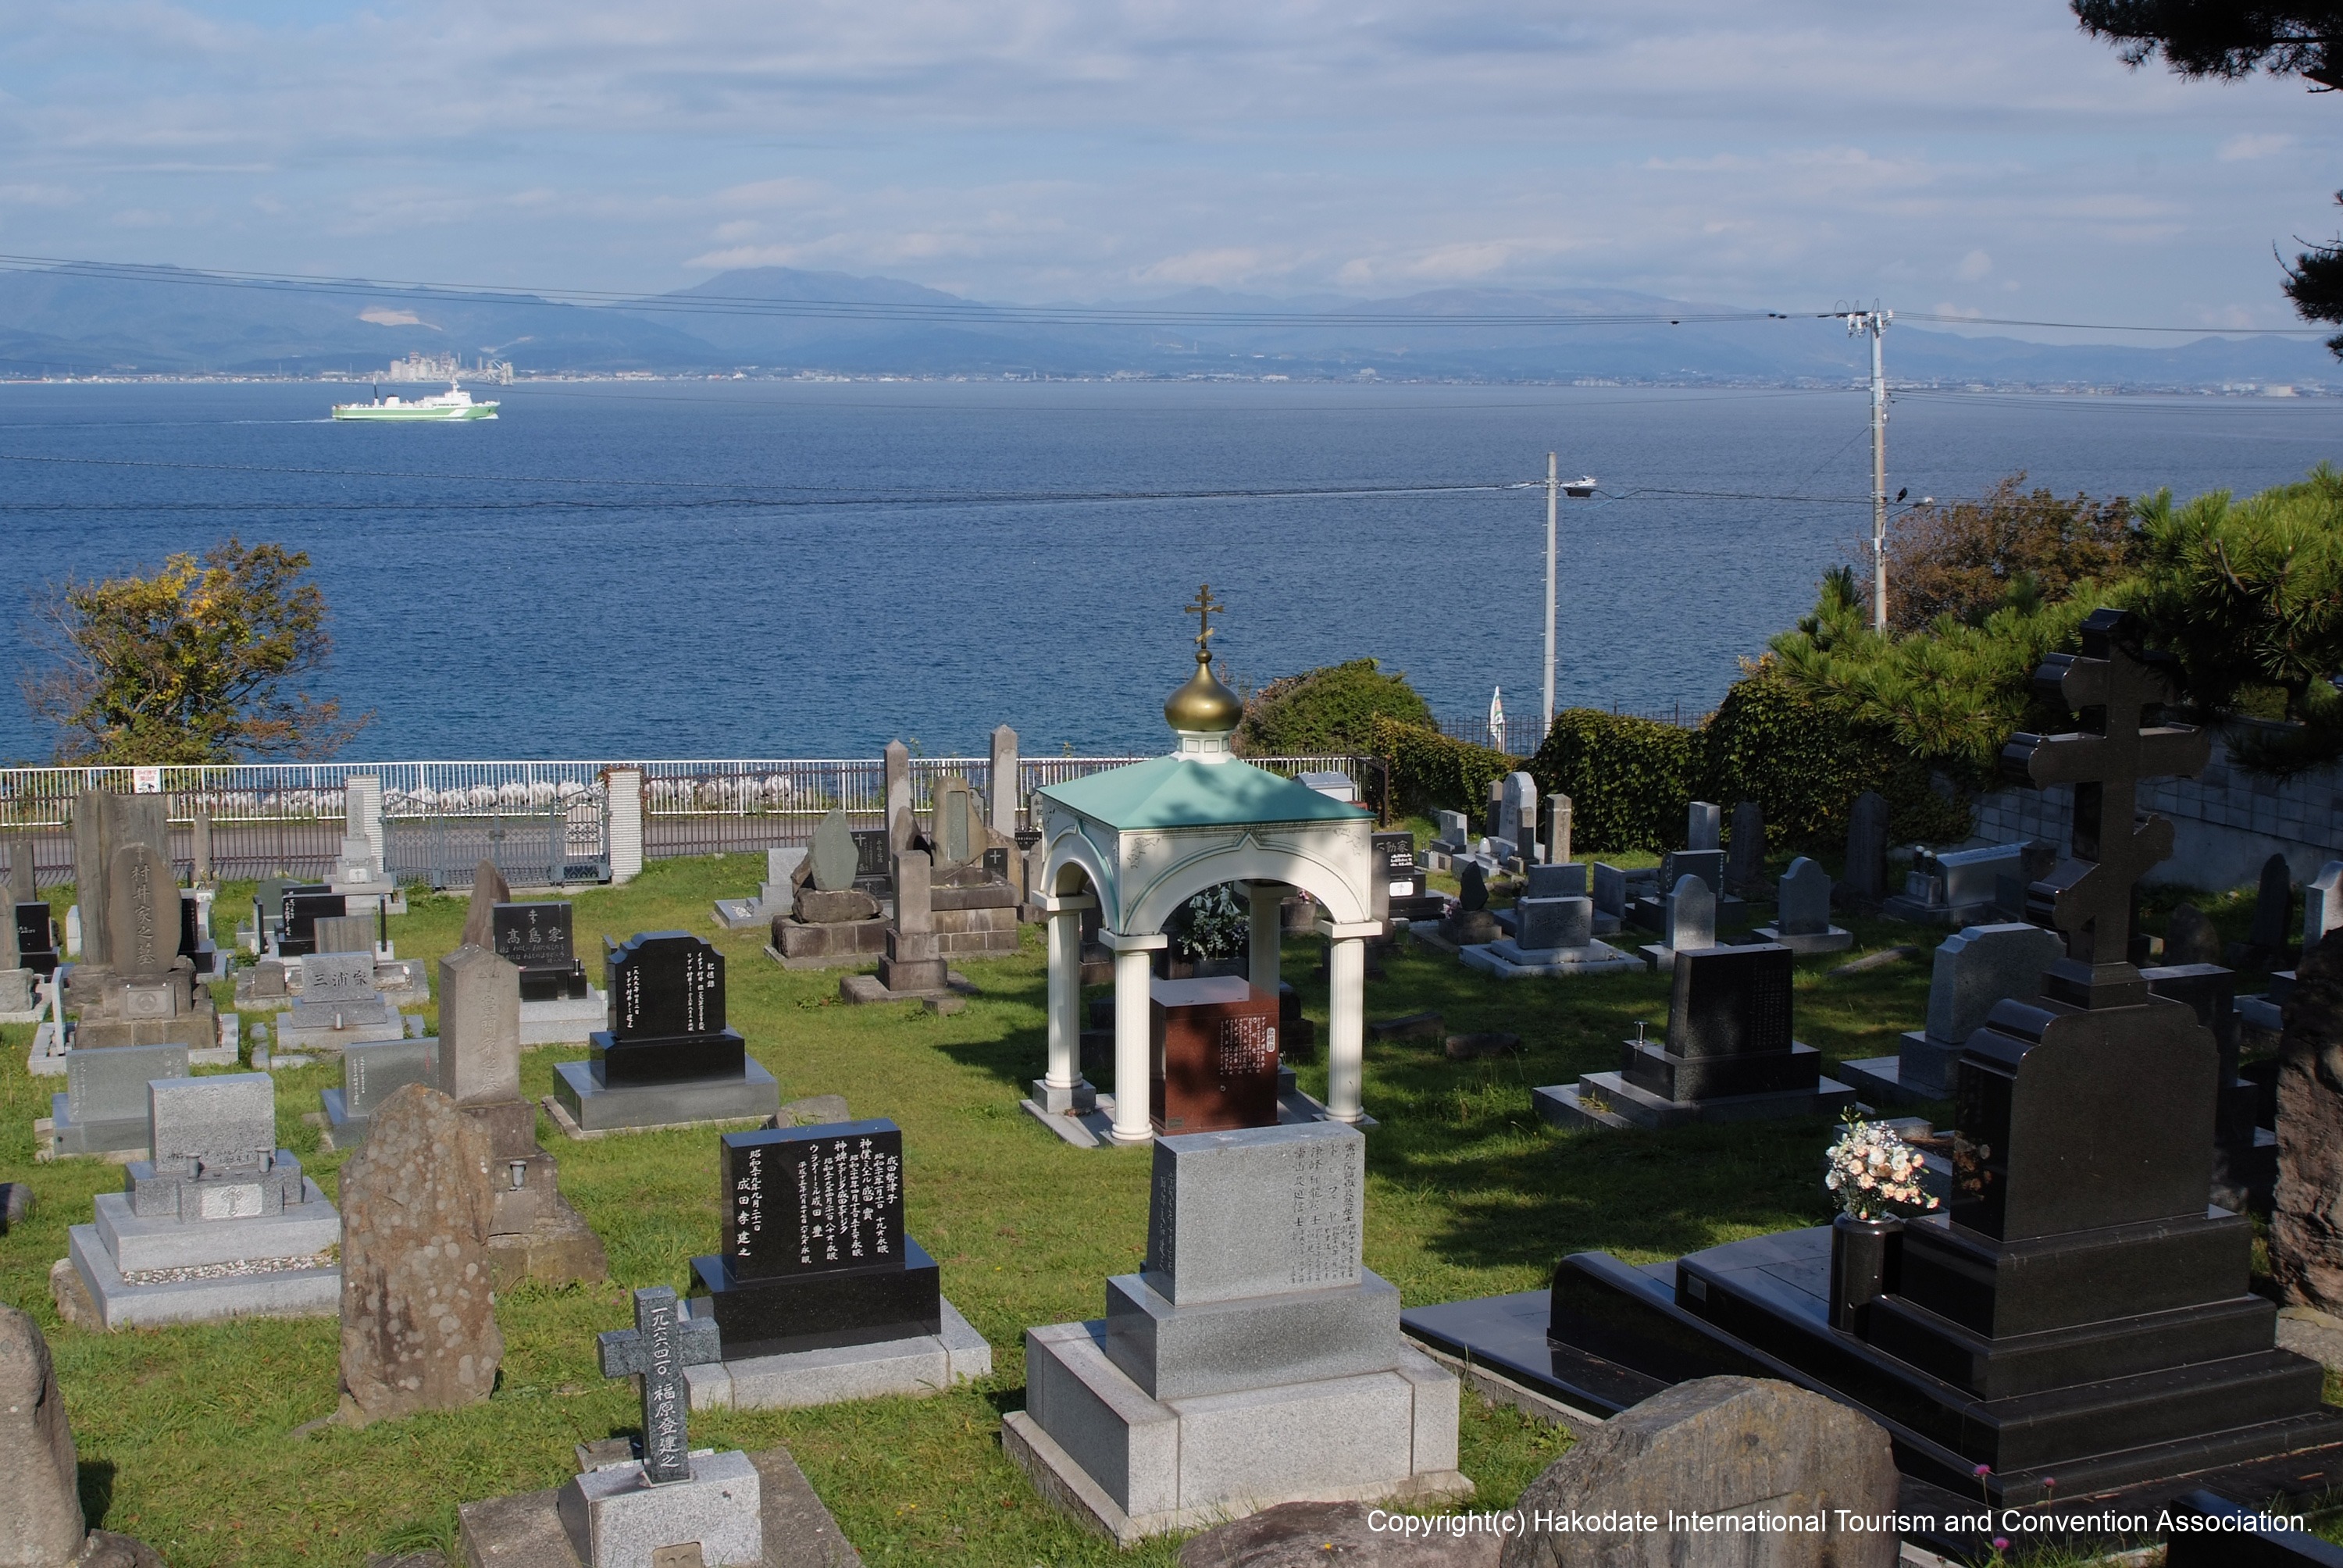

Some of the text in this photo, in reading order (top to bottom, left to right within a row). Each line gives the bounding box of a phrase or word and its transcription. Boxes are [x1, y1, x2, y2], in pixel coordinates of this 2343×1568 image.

[130, 863, 156, 965] 村井家之墓
[313, 970, 368, 987] 三浦家
[886, 1154, 898, 1204] 成田勢津子
[654, 1382, 680, 1469] 福原登建之
